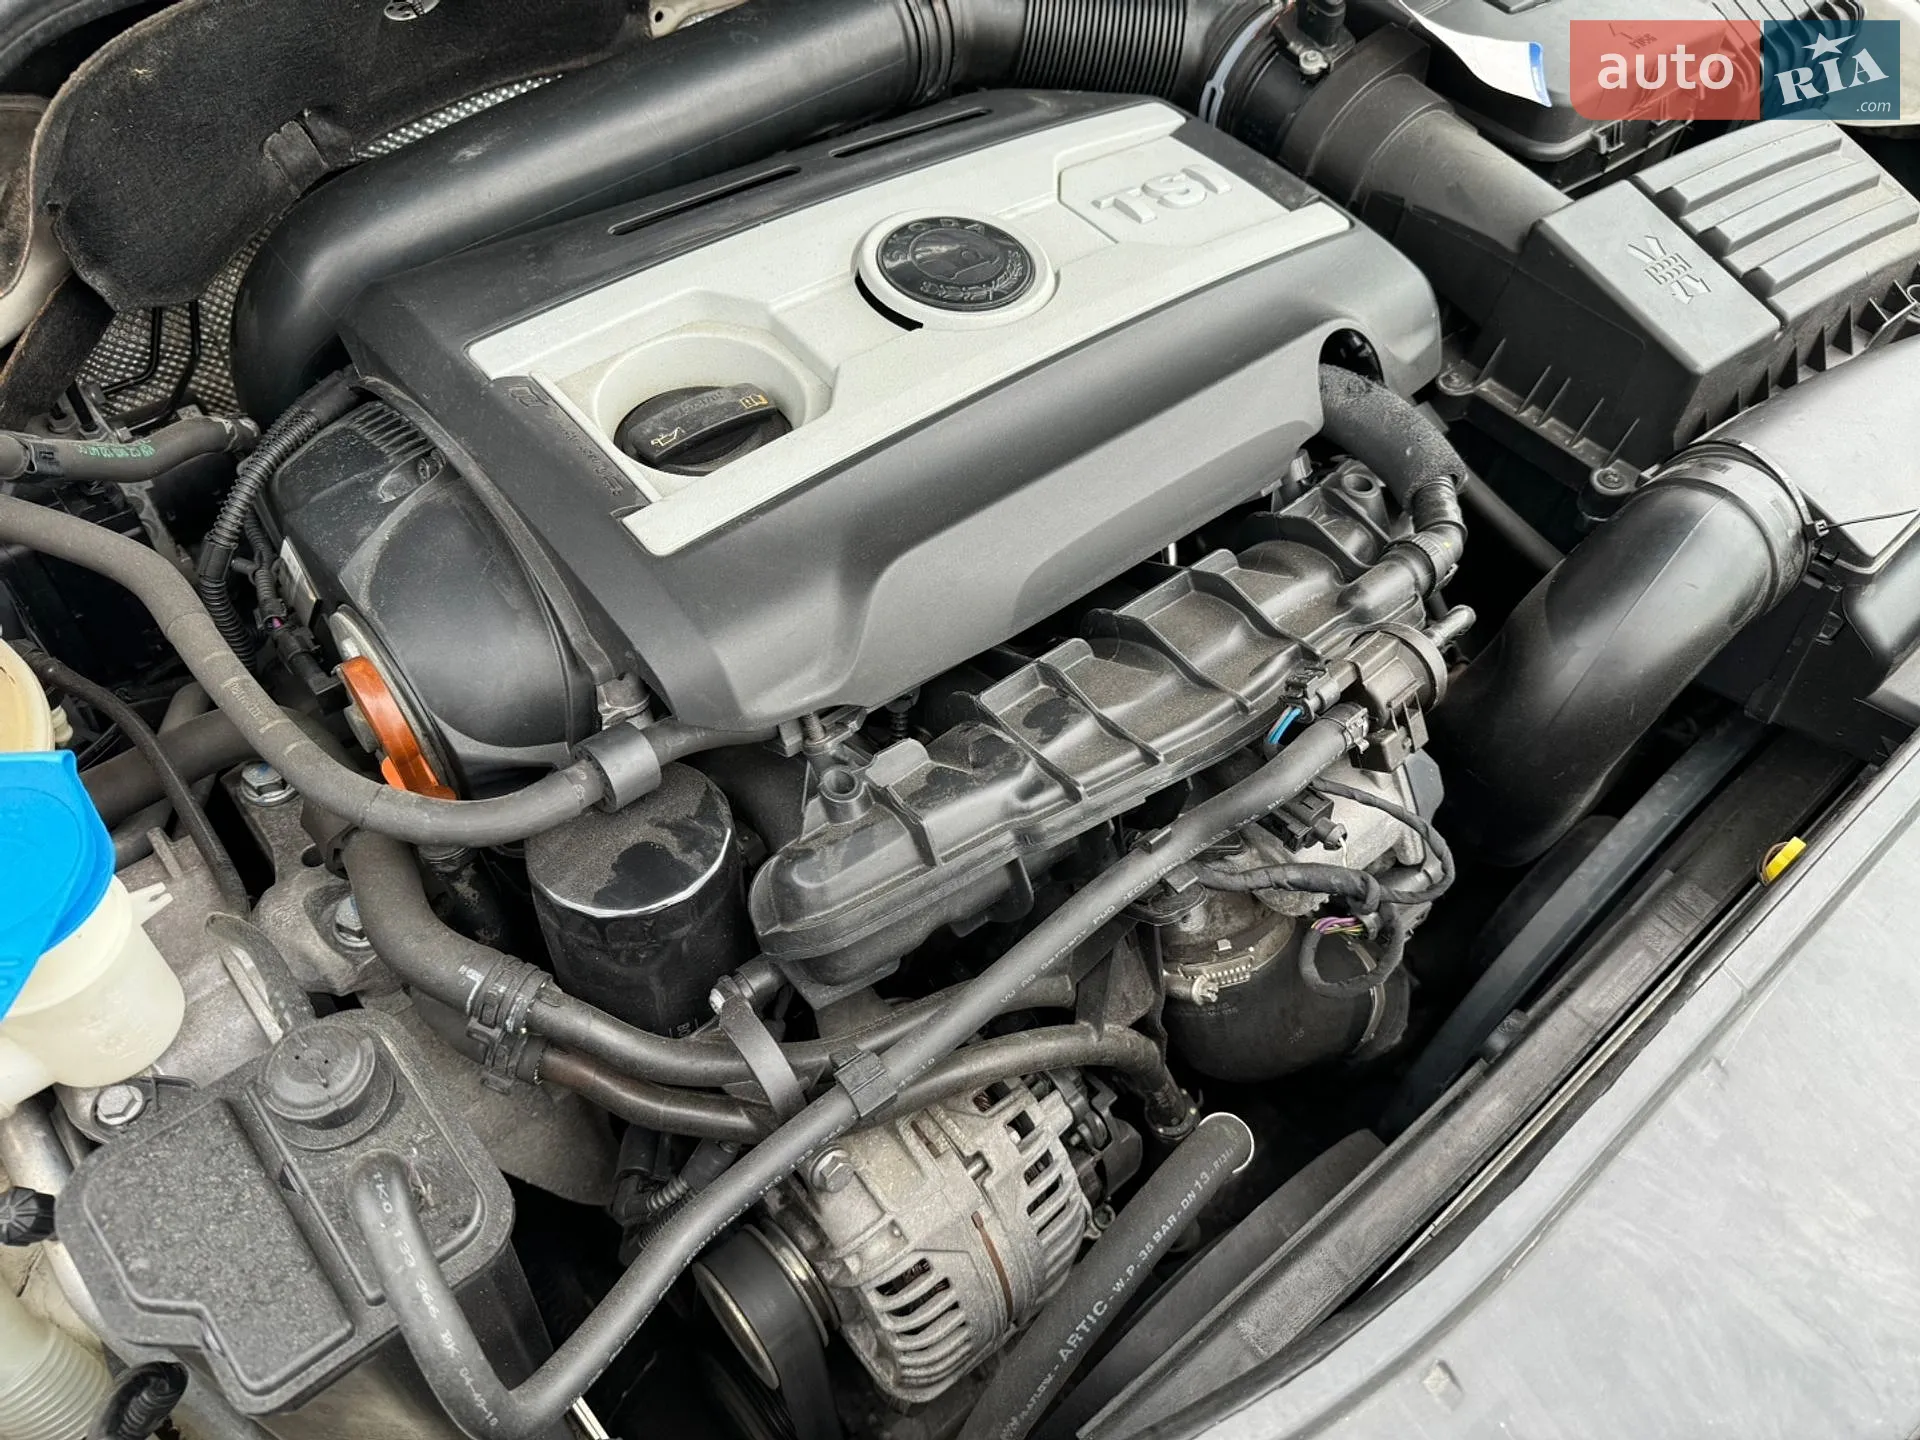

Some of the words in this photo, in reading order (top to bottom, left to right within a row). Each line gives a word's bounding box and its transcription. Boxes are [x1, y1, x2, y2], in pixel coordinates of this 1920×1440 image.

[1090, 164, 1232, 224] TSI
[1057, 1300, 1108, 1362] ARTIC
[1152, 1213, 1178, 1244] BAR
[1180, 1189, 1197, 1211] DN
[1193, 1170, 1211, 1192] 13
